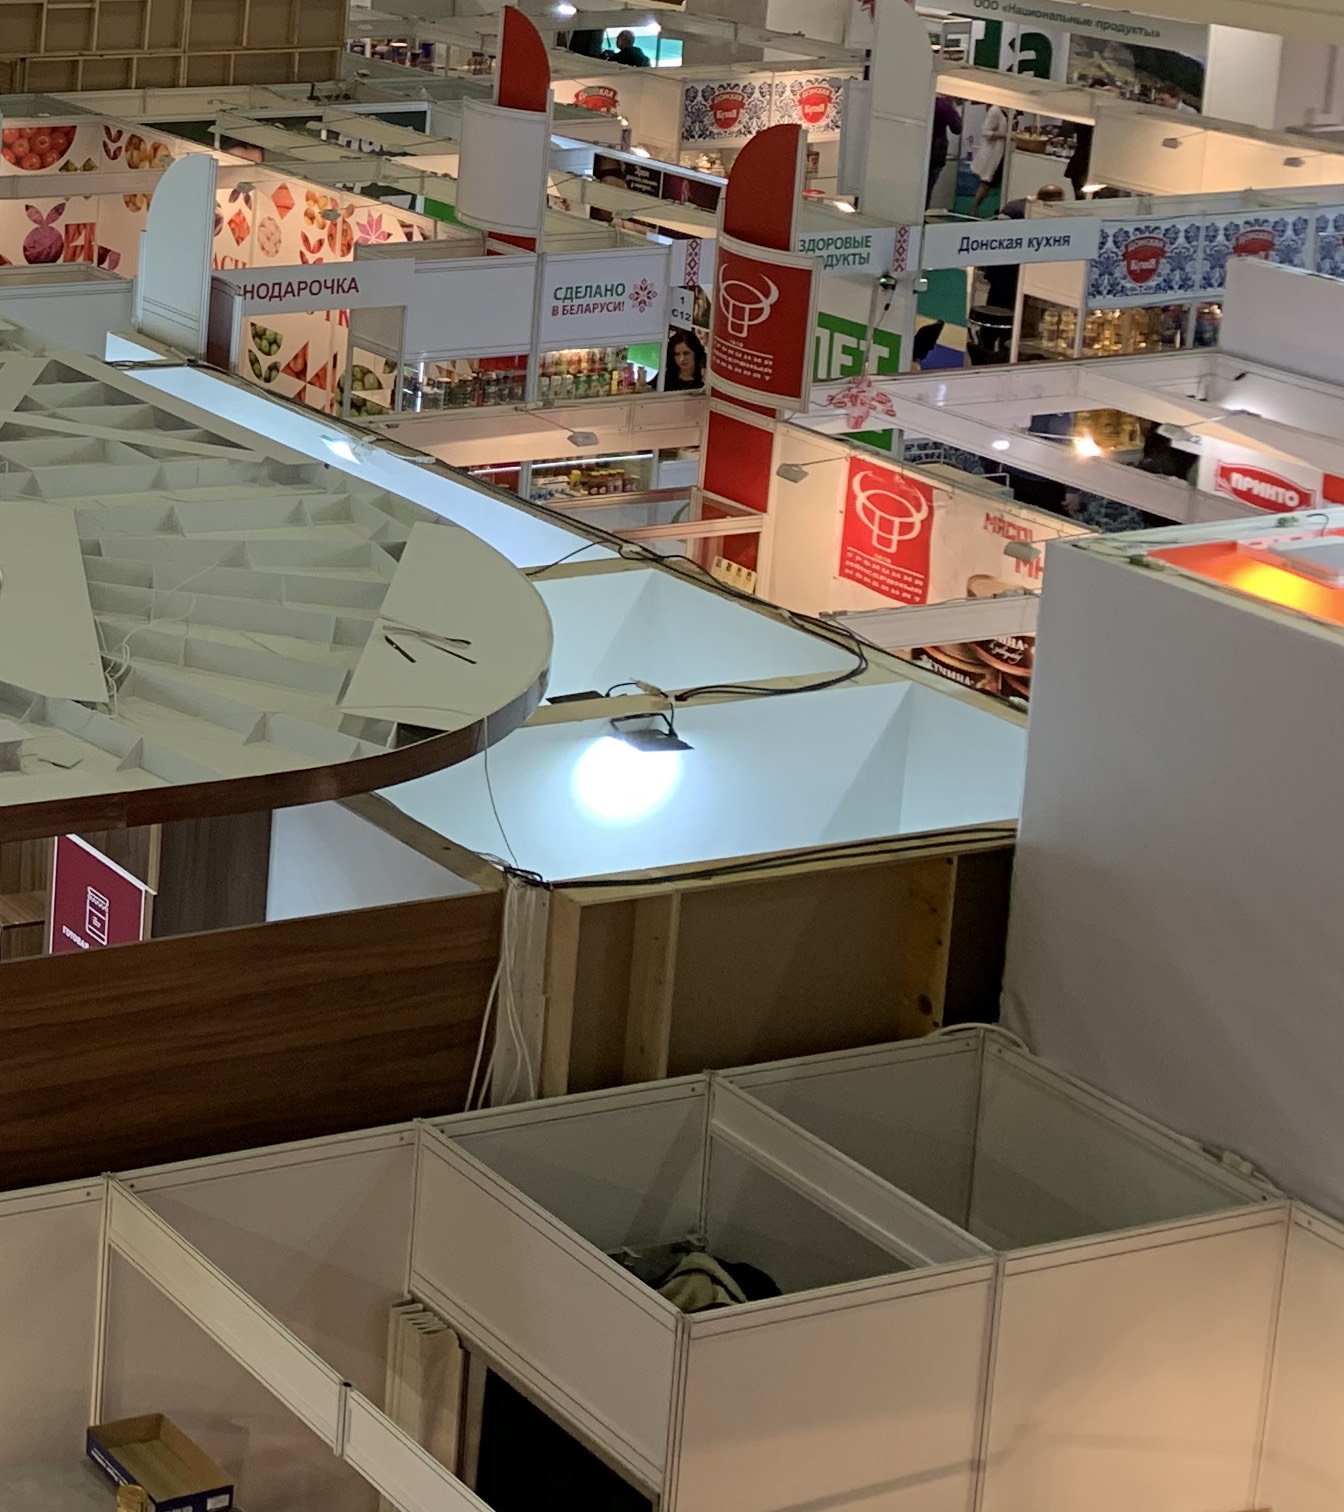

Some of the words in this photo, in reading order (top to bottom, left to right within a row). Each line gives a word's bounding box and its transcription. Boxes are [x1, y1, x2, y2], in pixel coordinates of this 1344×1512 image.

[799, 234, 872, 254] ЗДОРОВЫЕ
[957, 236, 1023, 255] Донская
[1027, 234, 1071, 250] кухня
[818, 252, 870, 270] ОДУКТЫ
[242, 276, 360, 302] НОДАРОЧКА
[553, 282, 626, 303] СДЕЛАНО
[551, 305, 559, 316] В
[562, 300, 625, 316] БЕЛАРУСИ!
[671, 308, 692, 322] C12
